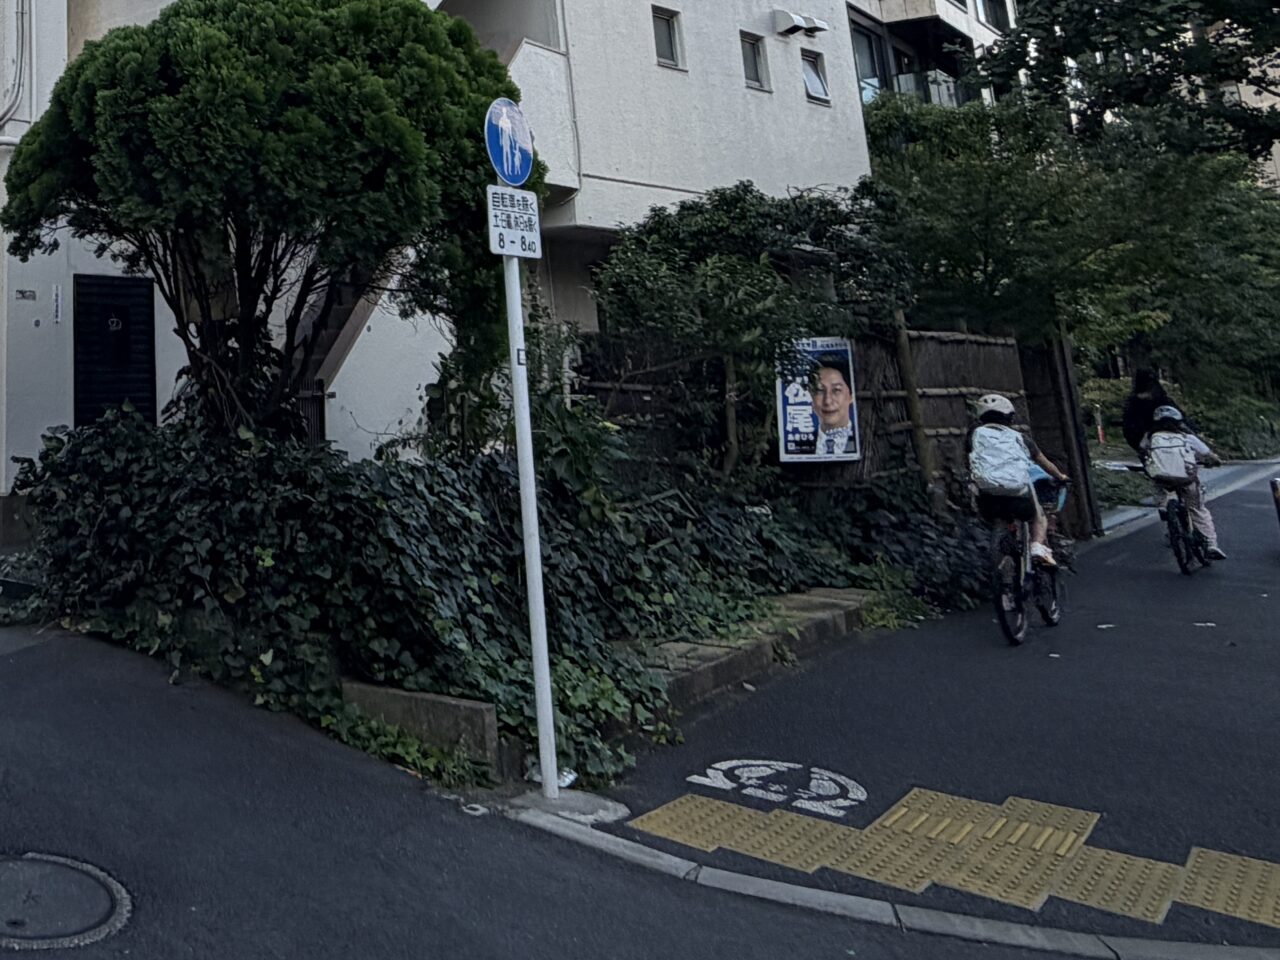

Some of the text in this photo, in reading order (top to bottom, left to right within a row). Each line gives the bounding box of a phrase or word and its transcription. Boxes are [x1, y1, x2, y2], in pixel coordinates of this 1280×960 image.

[492, 192, 536, 212] 自転車を除く
